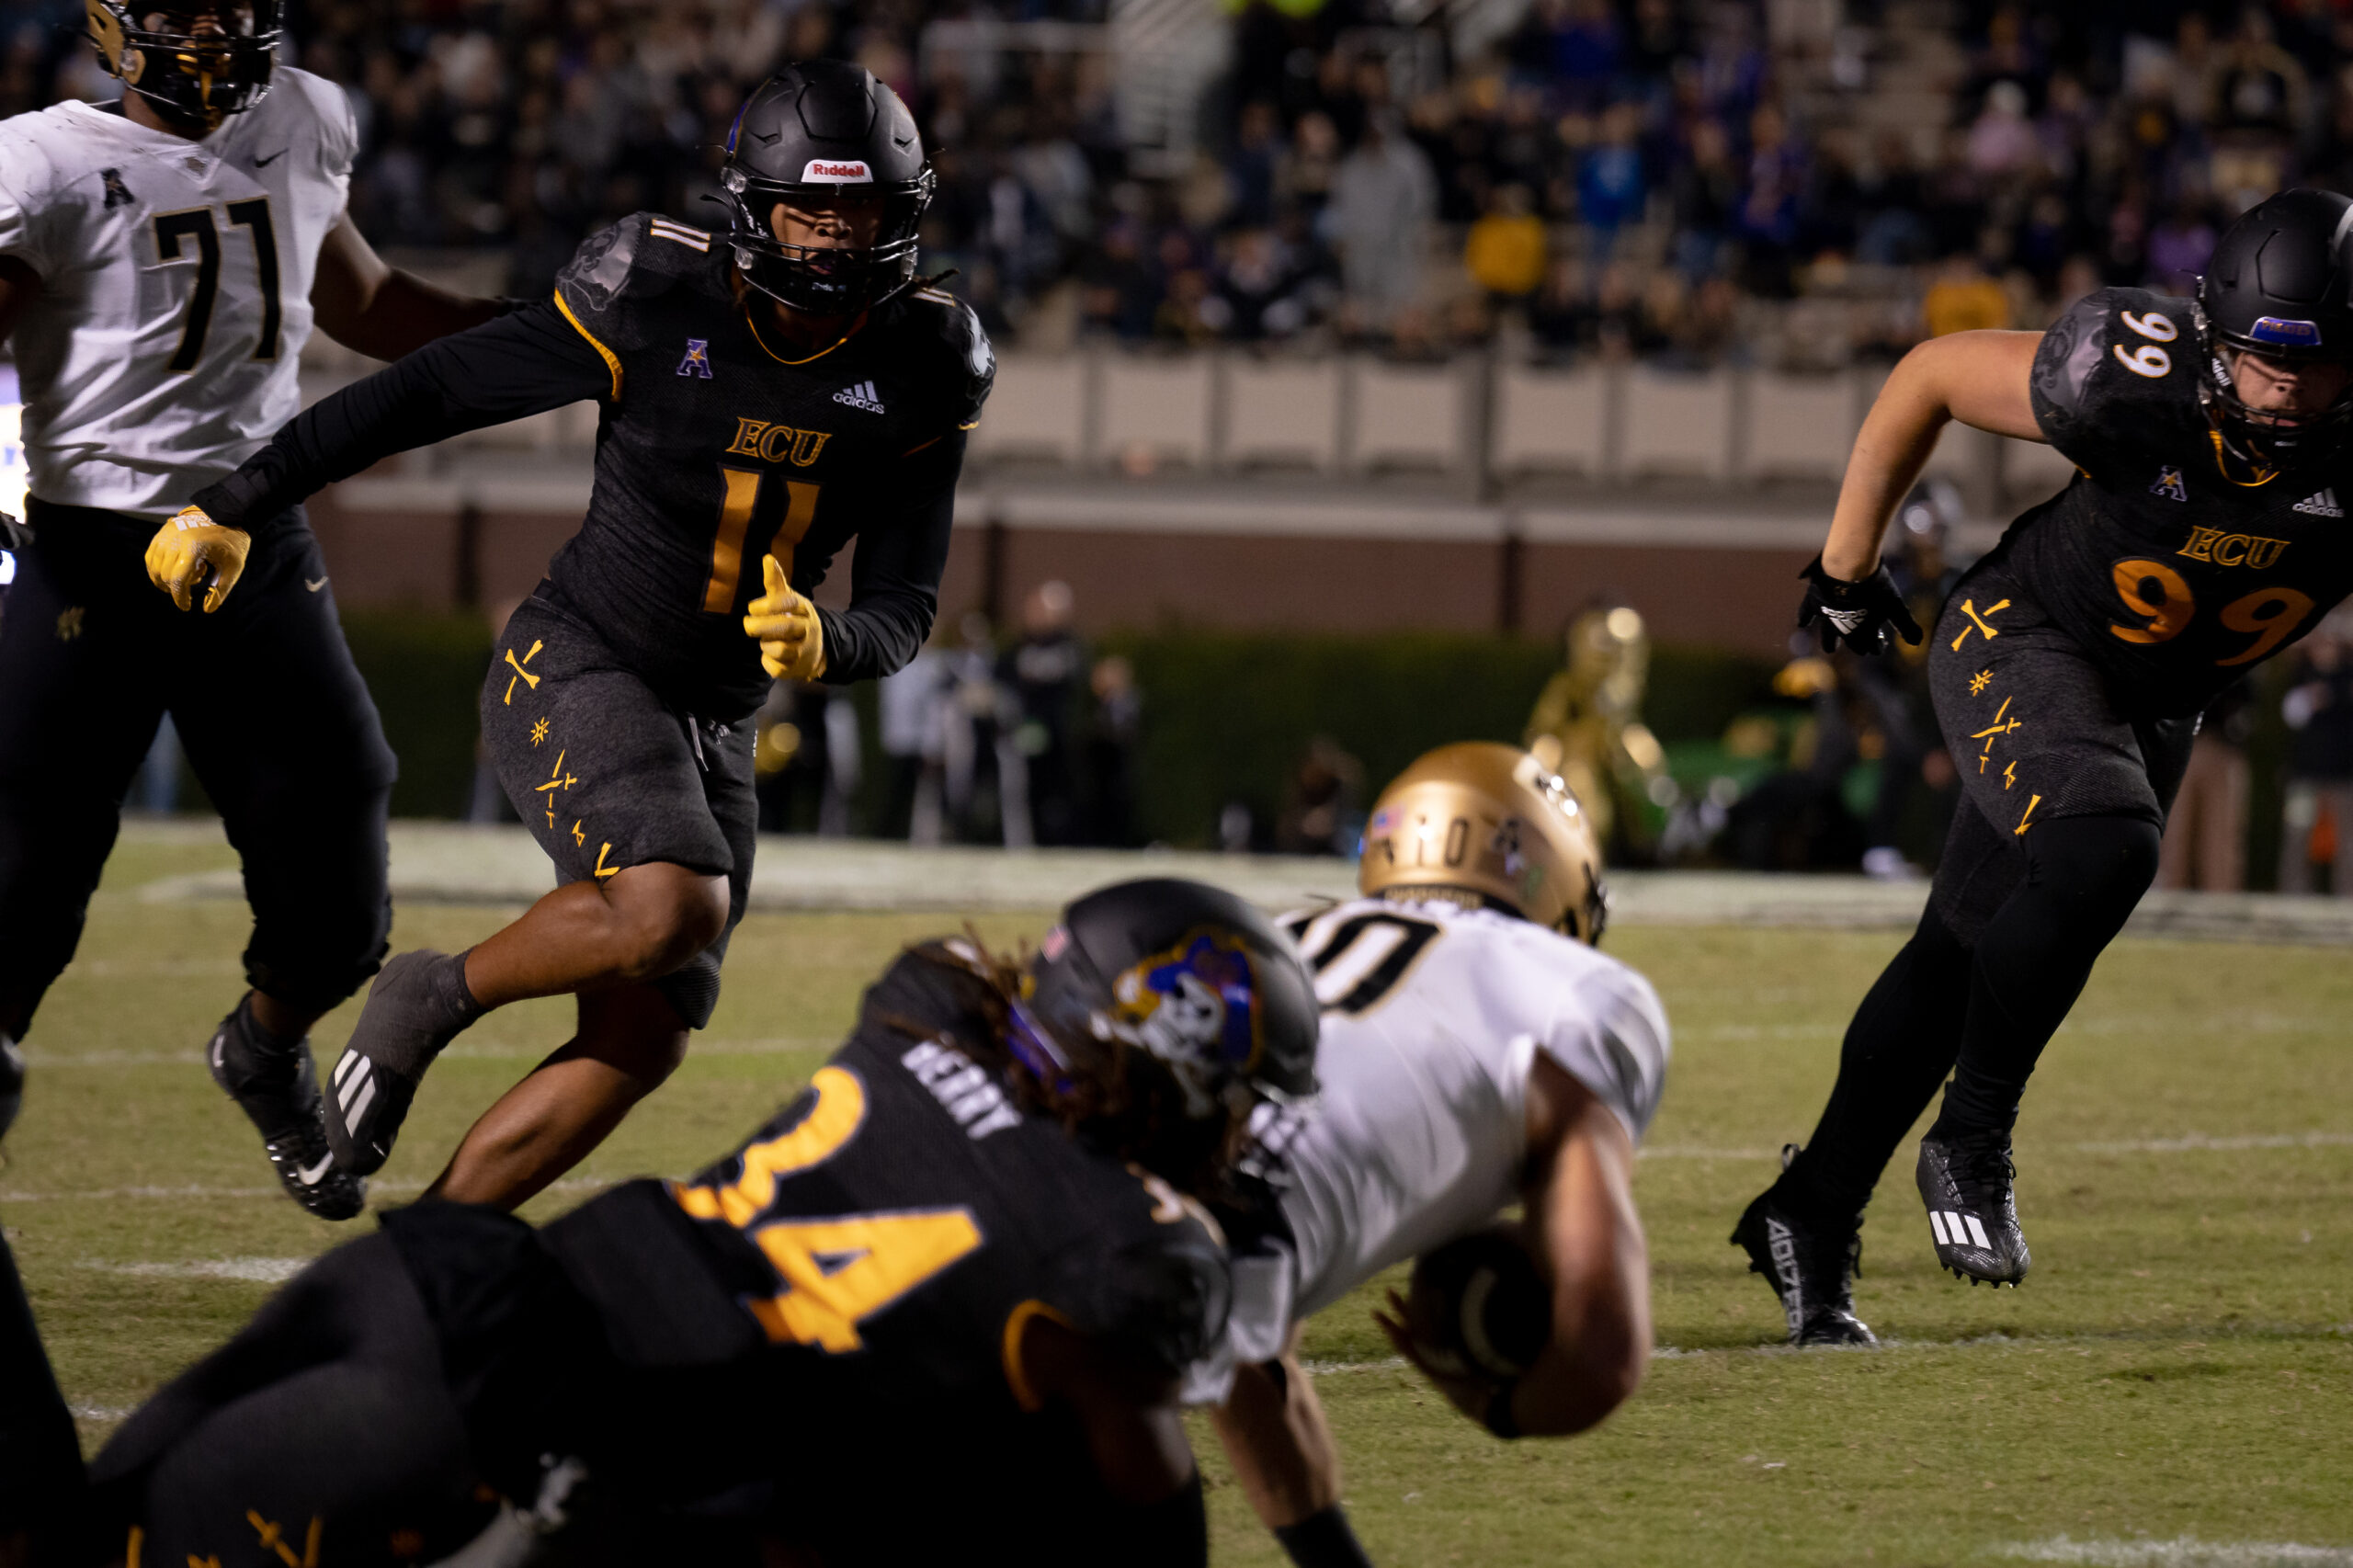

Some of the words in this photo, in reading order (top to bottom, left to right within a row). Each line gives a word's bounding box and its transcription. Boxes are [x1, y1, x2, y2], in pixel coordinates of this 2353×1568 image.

[813, 164, 864, 176] Riddell
[152, 195, 280, 374] 71
[2114, 310, 2179, 379] 99
[724, 415, 834, 467] ECU
[832, 392, 885, 415] adidas
[699, 460, 825, 617] 11
[2175, 525, 2292, 569] ECU
[2109, 556, 2317, 667] 99
[1289, 913, 1442, 1015] 0
[662, 1063, 986, 1356] 34
